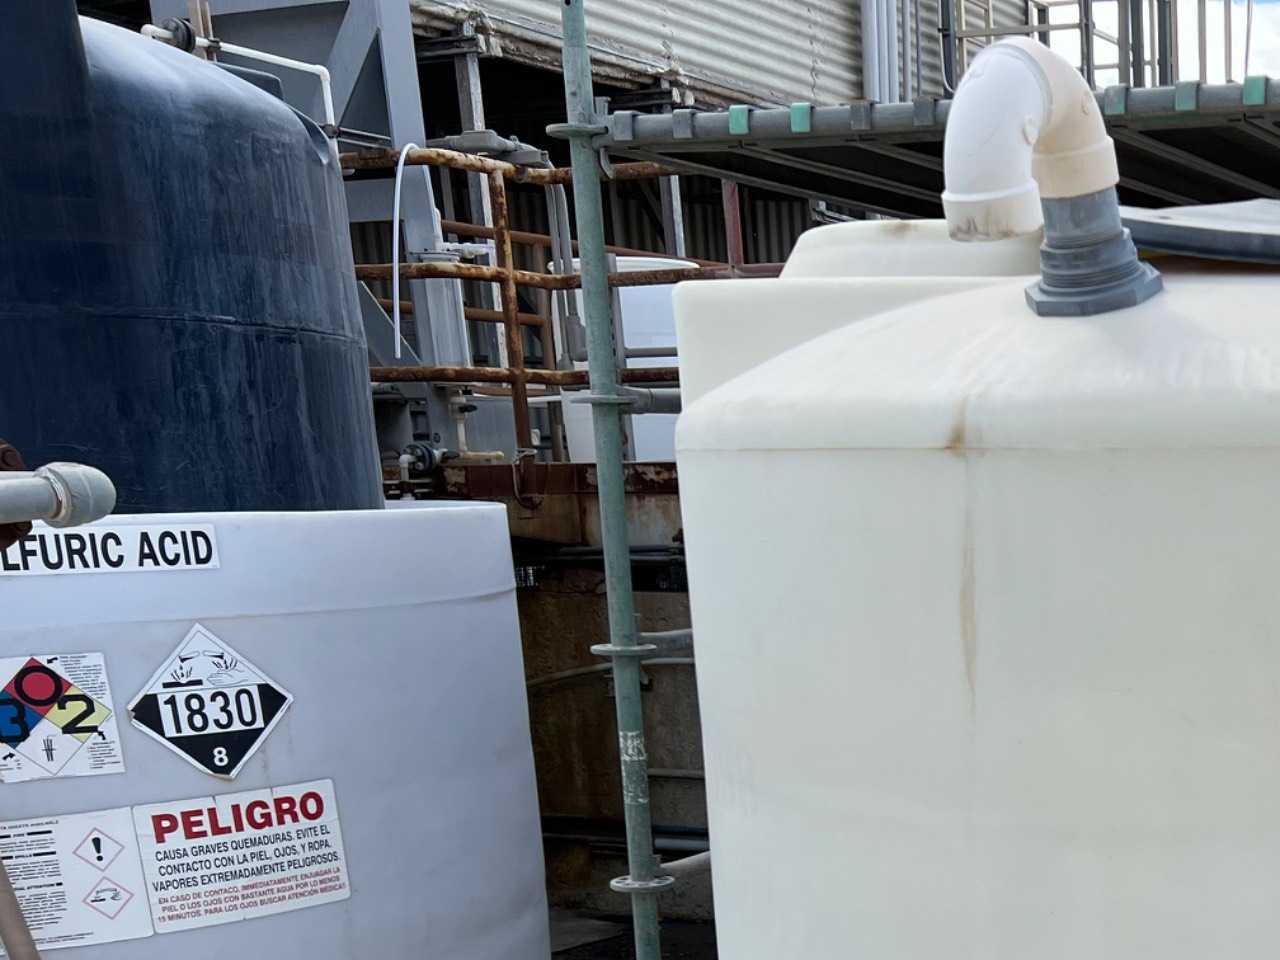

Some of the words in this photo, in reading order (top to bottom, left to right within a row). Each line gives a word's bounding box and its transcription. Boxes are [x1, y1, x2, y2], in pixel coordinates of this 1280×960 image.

[138, 530, 213, 567] ACID
[57, 694, 99, 735] 2
[163, 688, 257, 735] 1830
[212, 746, 229, 767] 8
[151, 791, 325, 844] PELIGRO
[155, 847, 189, 862] CAUSA
[191, 841, 229, 857] GRAVES
[230, 831, 294, 850] QUEMADURAS.
[296, 825, 319, 840] EVITE
[320, 824, 330, 835] EL
[158, 859, 212, 877] CONTACTO
[214, 856, 235, 868] CON
[236, 853, 249, 865] LA
[301, 842, 306, 853] Y
[152, 876, 199, 892] VAPORES
[201, 860, 286, 885] EXTREMADAMENTE
[161, 905, 178, 913] PIEL
[187, 901, 201, 909] LOS
[203, 898, 223, 907] OJOS
[224, 895, 240, 903] CON
[170, 894, 191, 903] CASO
[224, 904, 239, 912] LOS
[240, 900, 258, 909] OJOS
